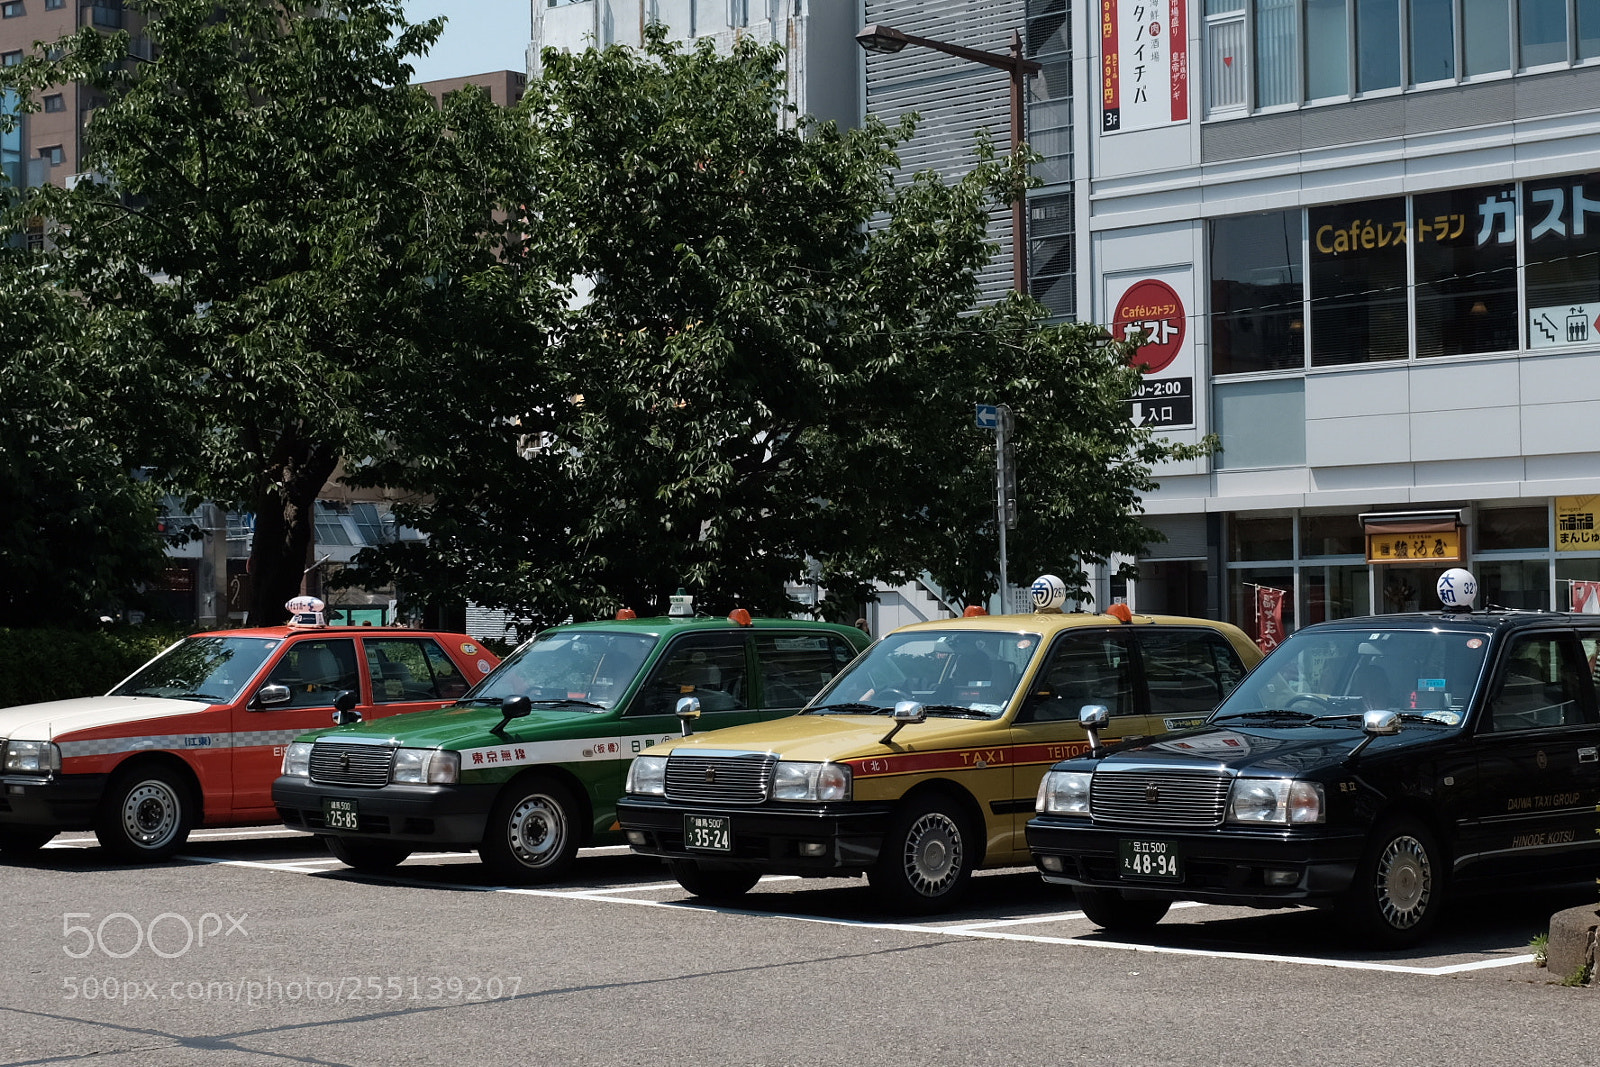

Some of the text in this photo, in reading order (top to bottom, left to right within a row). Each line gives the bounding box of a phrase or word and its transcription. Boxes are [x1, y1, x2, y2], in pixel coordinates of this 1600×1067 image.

[1105, 112, 1118, 126] 3F
[1477, 185, 1600, 246] ガスト
[1148, 406, 1173, 421] 入口
[1560, 532, 1600, 544] まんじゅ
[1439, 574, 1457, 603] 大和
[184, 736, 212, 748] (江東)
[472, 748, 526, 765] 東京無線
[960, 750, 1005, 766] TAXI
[1047, 745, 1078, 758] TEITO
[1535, 795, 1552, 808] TAXI
[1553, 792, 1581, 807] GROUP
[330, 810, 358, 828] 25-85
[694, 828, 729, 849] 35-24
[1132, 853, 1177, 876] 48-94
